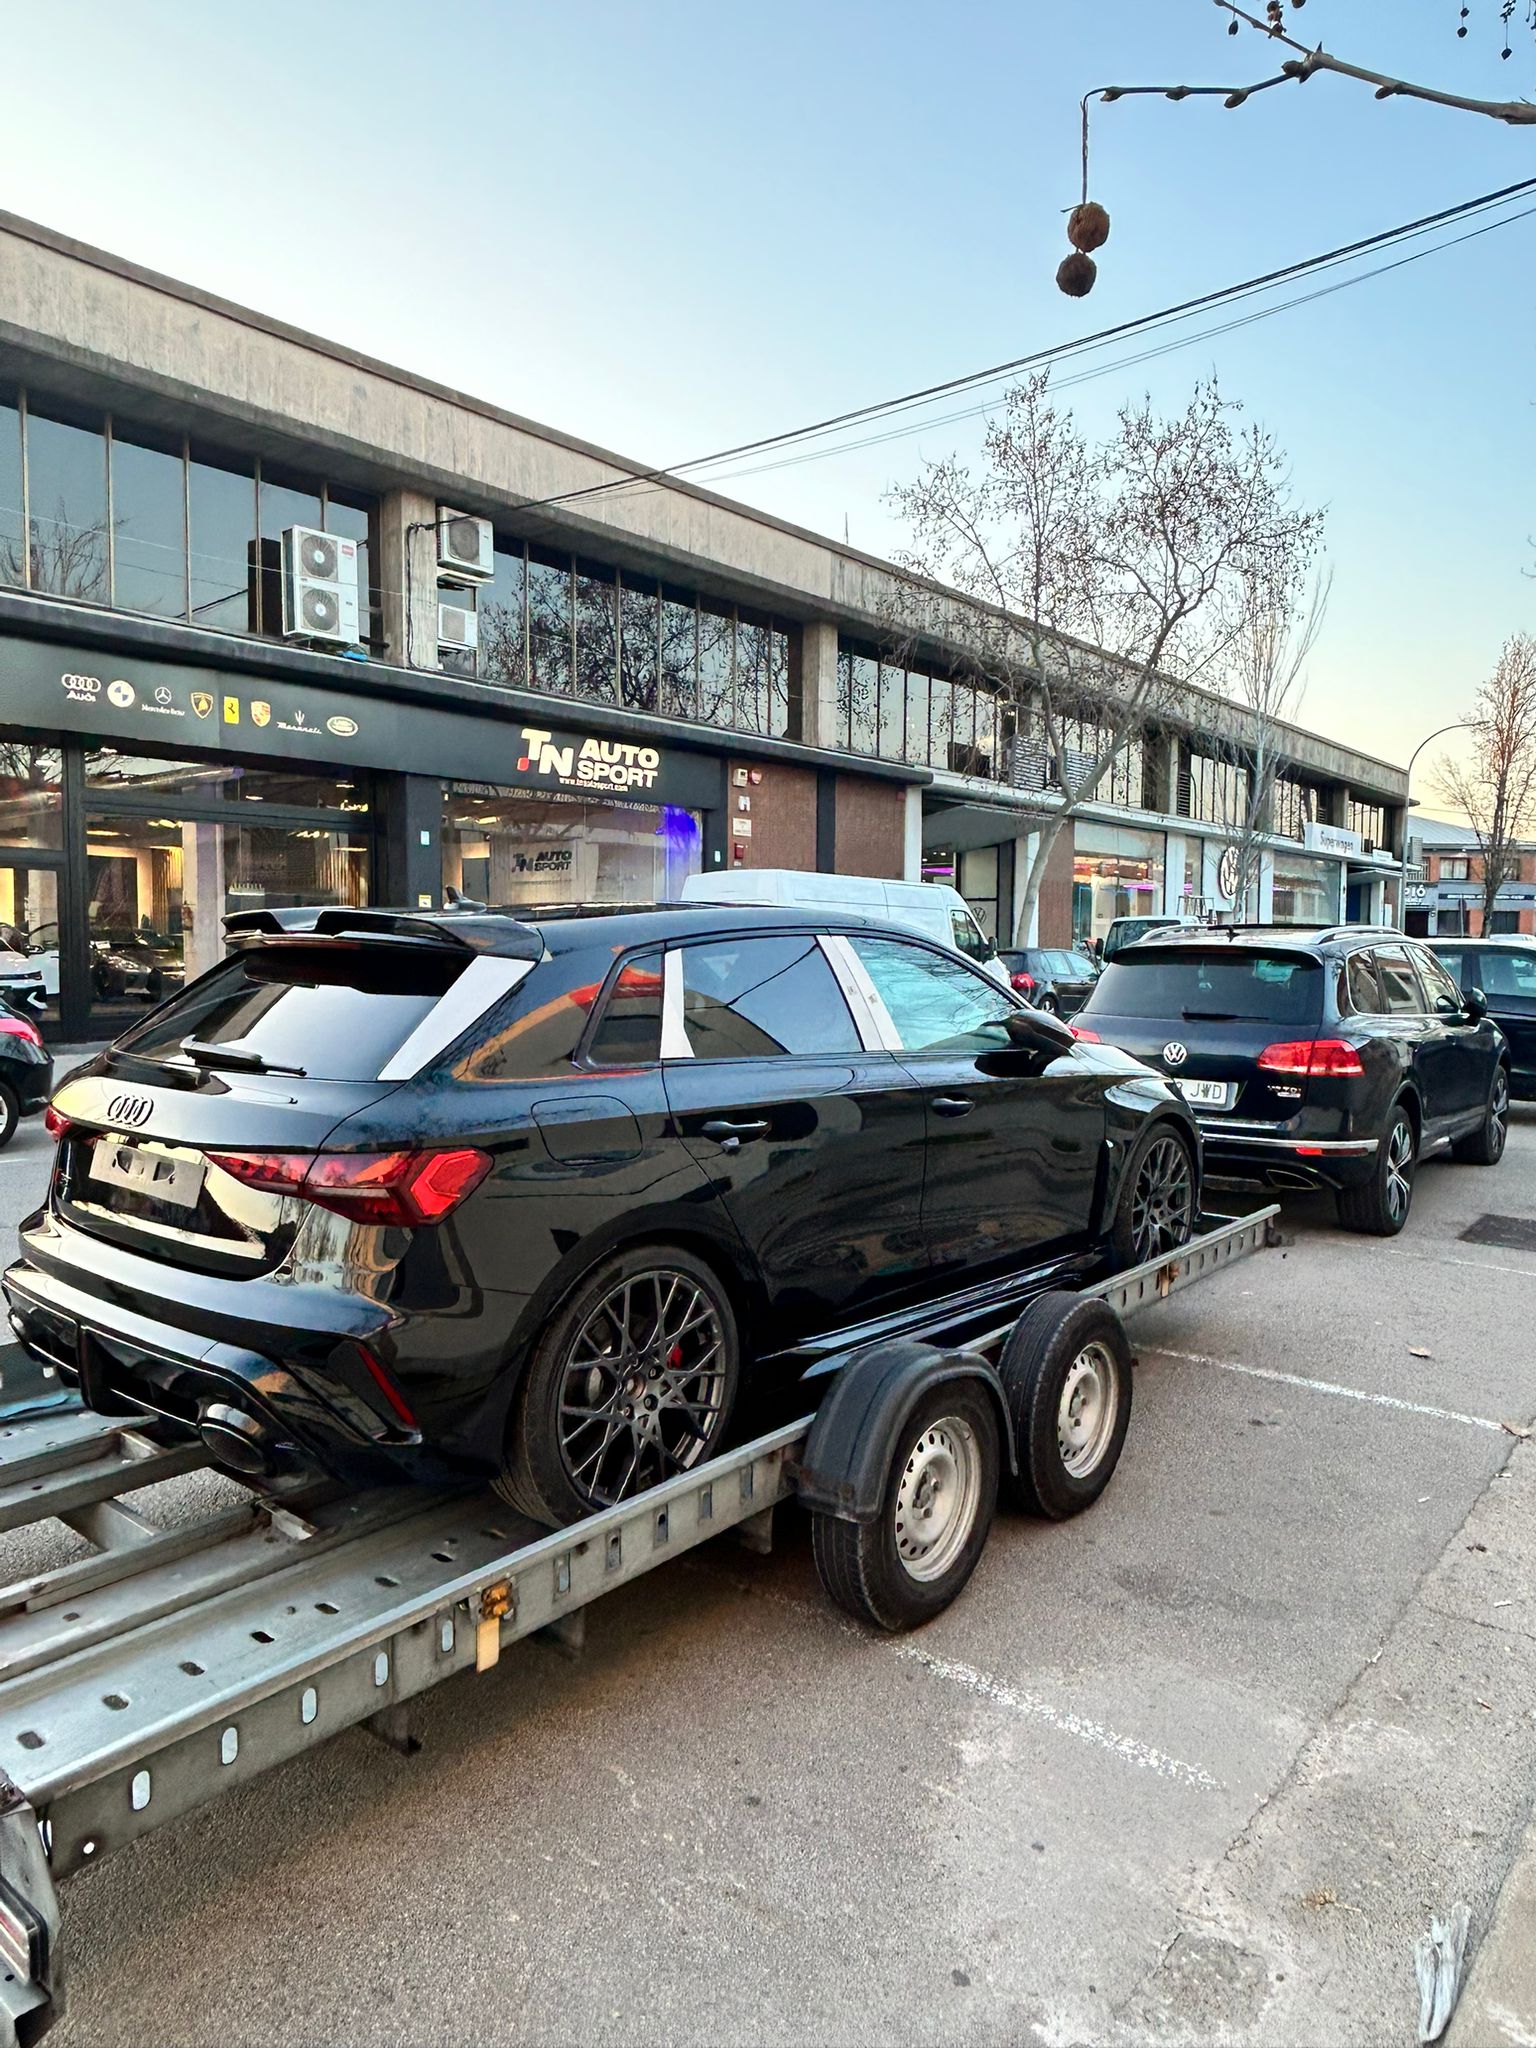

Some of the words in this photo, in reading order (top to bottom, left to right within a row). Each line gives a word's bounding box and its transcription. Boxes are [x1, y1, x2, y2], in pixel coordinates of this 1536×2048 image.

[578, 738, 660, 769] AUTO
[577, 760, 658, 788] SPORT
[535, 851, 573, 861] AUTO
